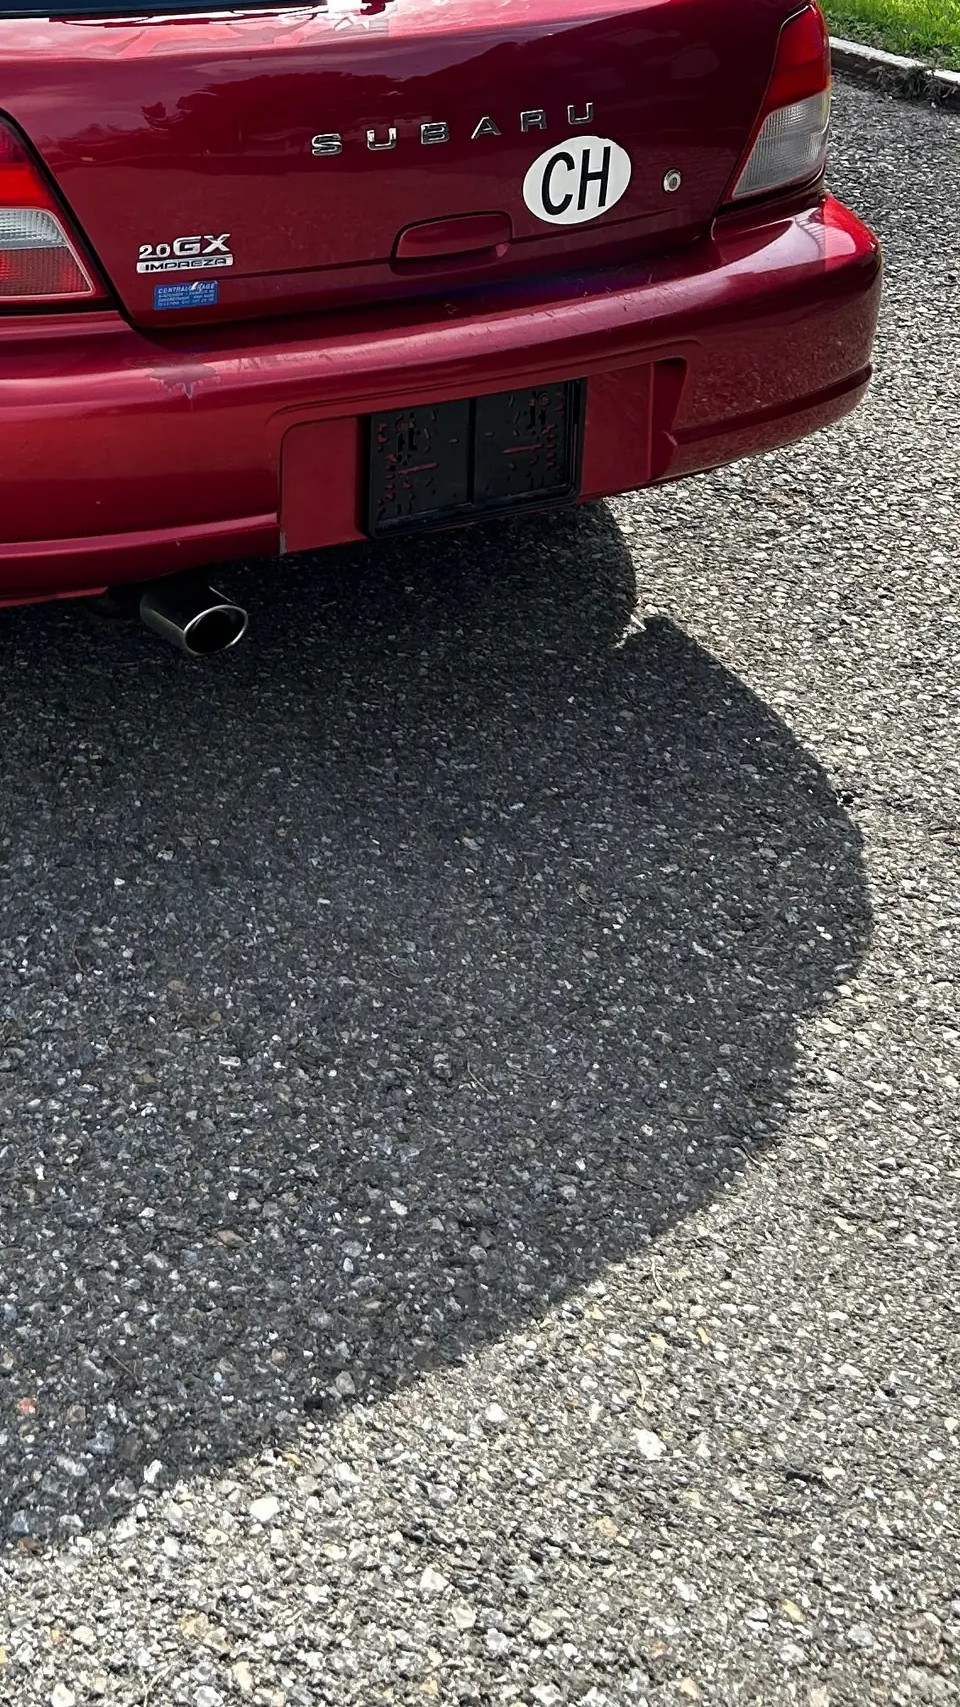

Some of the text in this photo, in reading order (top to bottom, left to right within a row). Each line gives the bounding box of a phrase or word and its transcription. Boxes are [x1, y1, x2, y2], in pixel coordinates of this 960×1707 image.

[311, 102, 594, 157] SUBARU
[541, 146, 611, 216] CH
[145, 257, 226, 271] IMPREZA
